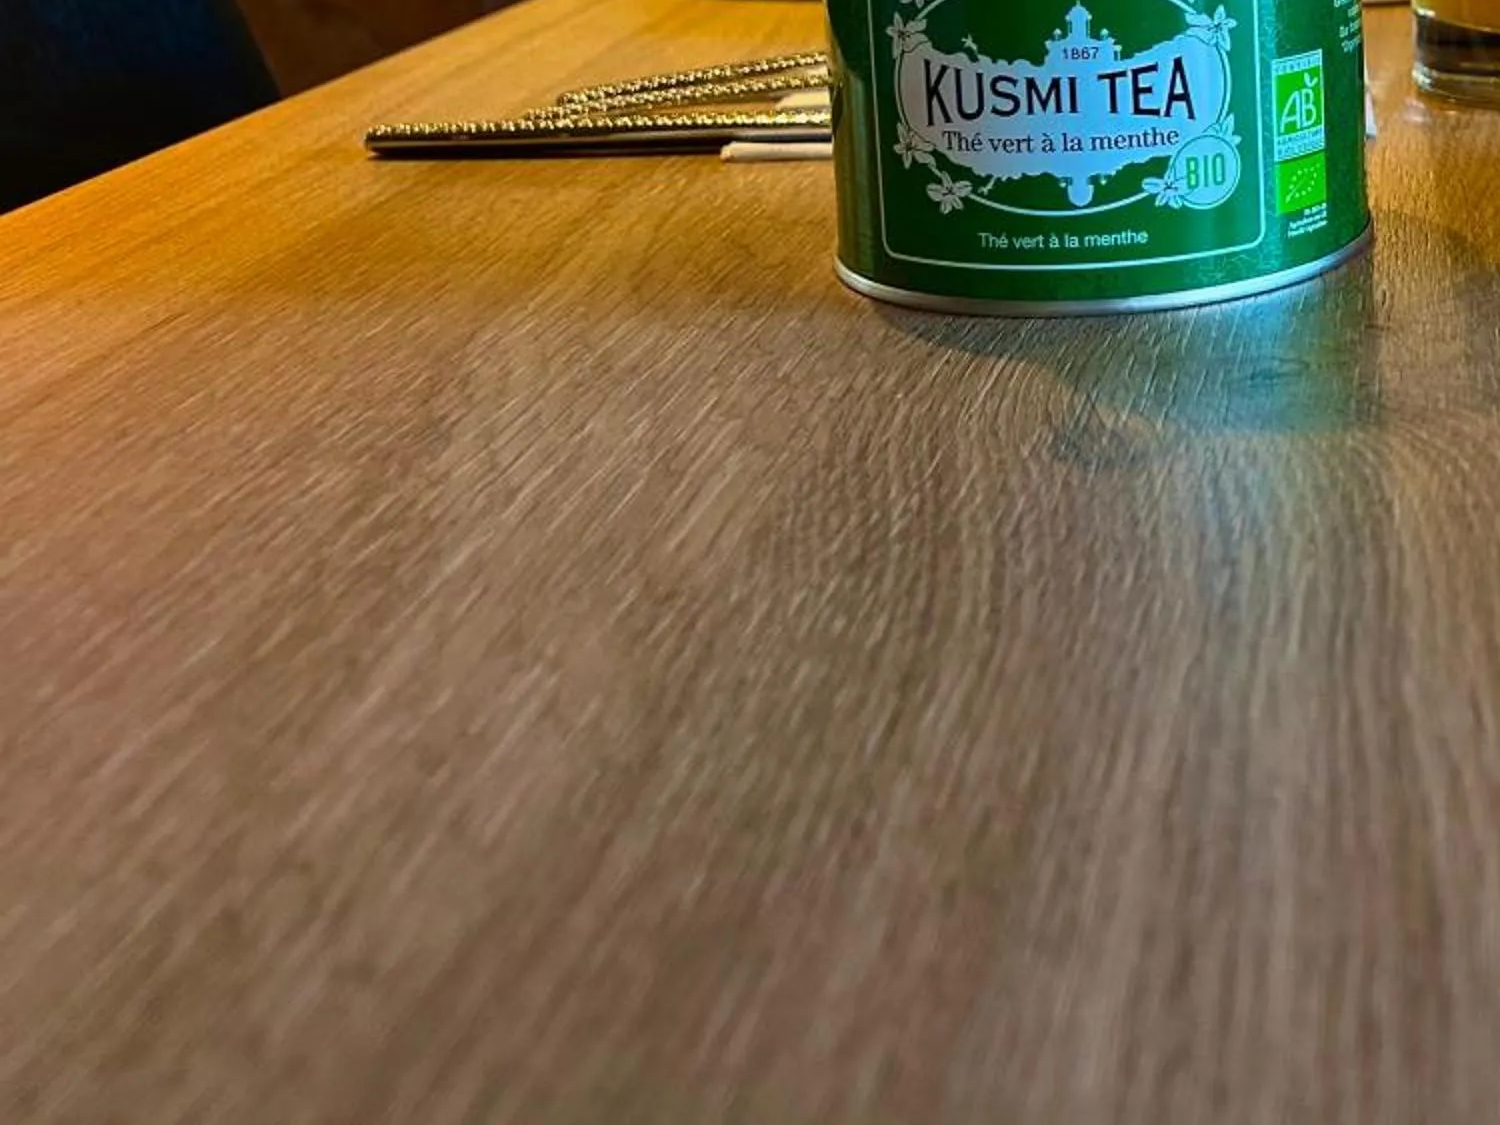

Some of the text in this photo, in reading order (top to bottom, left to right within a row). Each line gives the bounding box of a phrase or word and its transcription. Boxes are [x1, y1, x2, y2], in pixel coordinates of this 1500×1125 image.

[1061, 47, 1099, 61] 1867
[923, 56, 1197, 126] KUSMI TEA
[1280, 88, 1317, 133] AB
[942, 126, 1181, 154] Thé vert à la menthe
[1185, 152, 1226, 190] BIO
[977, 229, 1149, 250] Thé vert à la menthe
